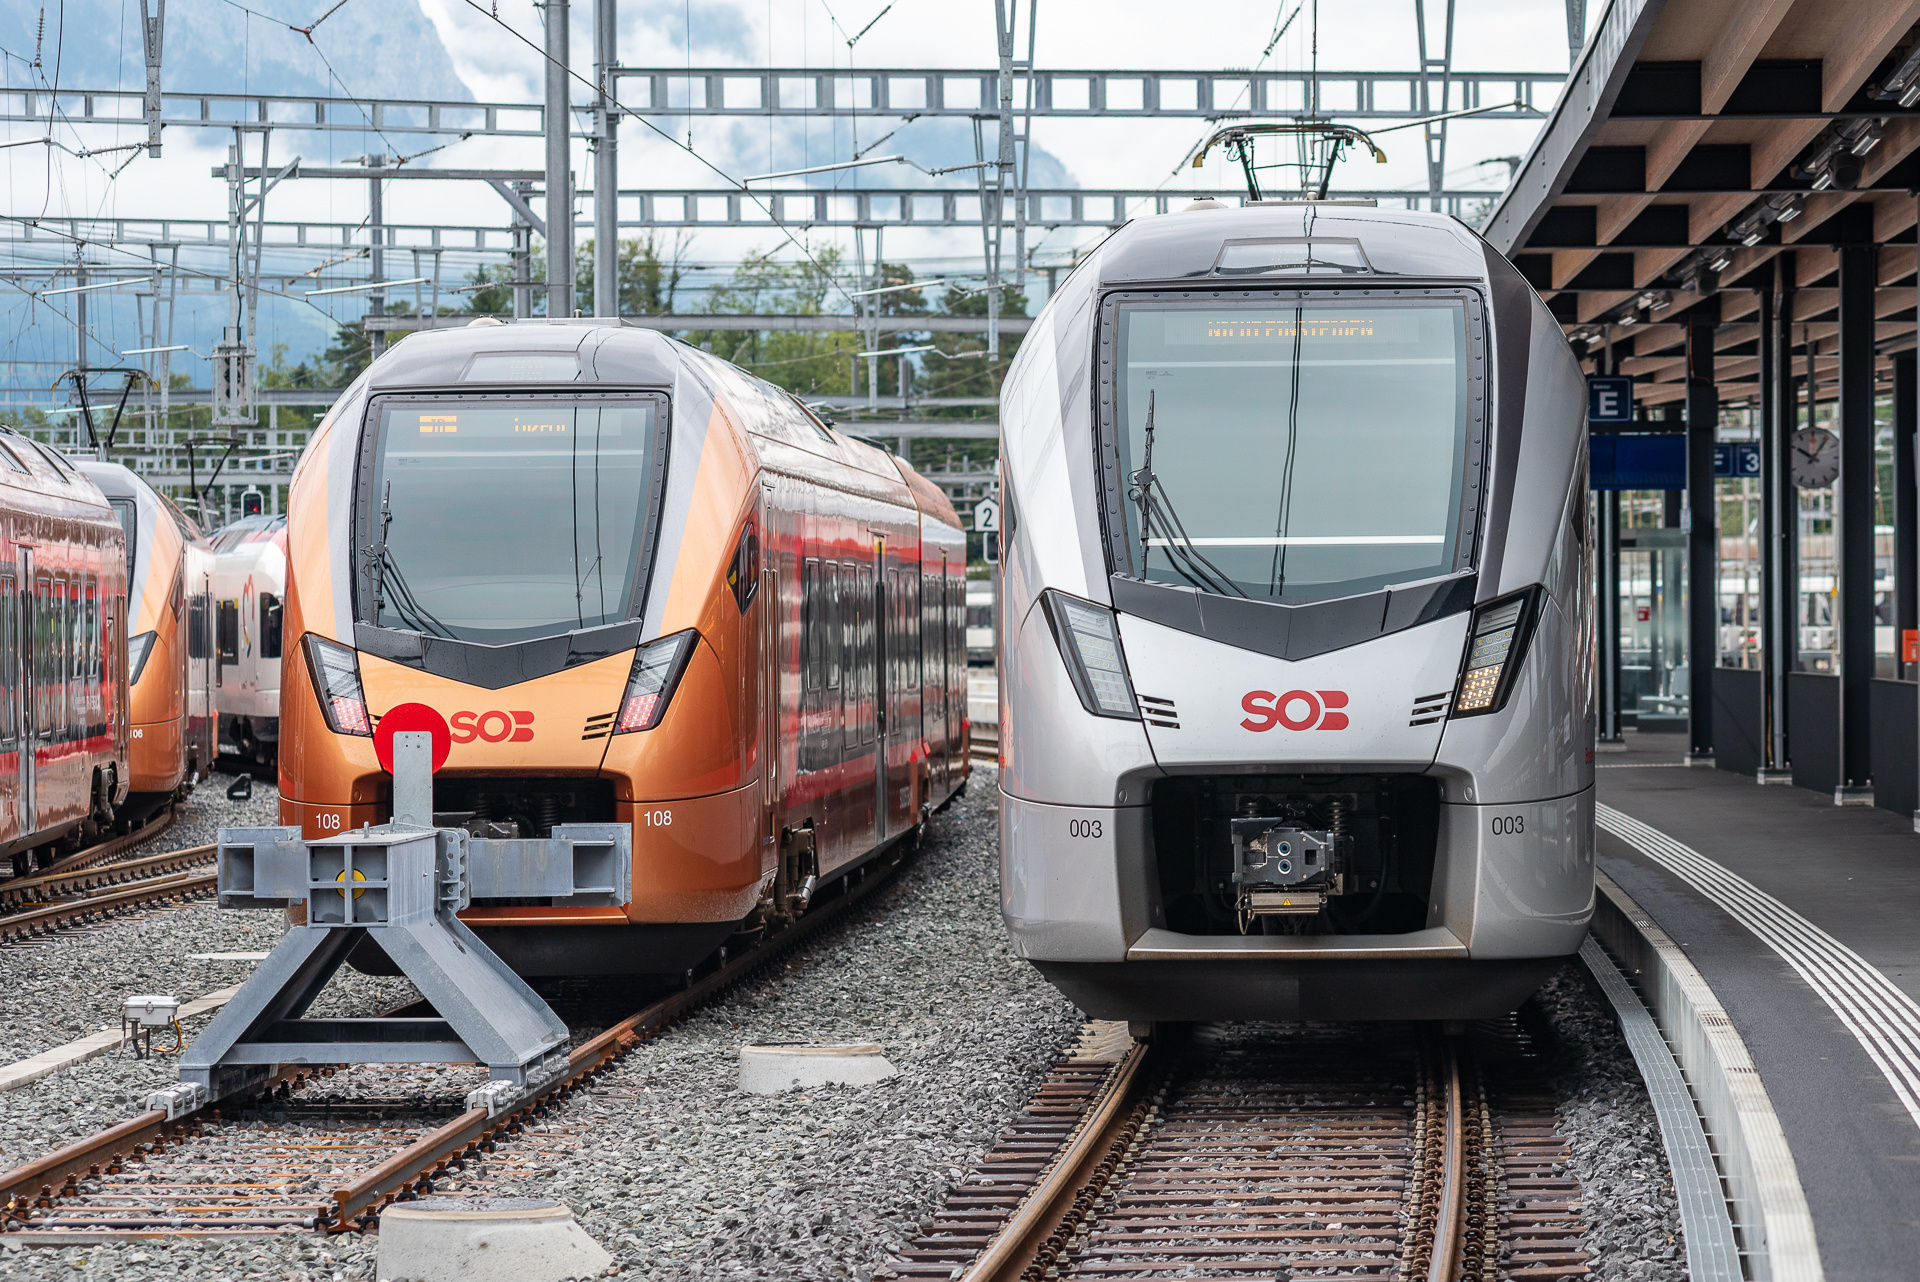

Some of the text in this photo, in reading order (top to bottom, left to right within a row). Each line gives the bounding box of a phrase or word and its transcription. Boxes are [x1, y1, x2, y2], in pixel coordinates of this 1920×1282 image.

[1599, 391, 1618, 416] E
[1745, 452, 1760, 472] 3
[983, 507, 993, 528] 2
[1239, 689, 1350, 733] SOB
[450, 710, 535, 744] SOB
[315, 812, 341, 830] 108
[643, 809, 673, 827] 108
[1069, 818, 1103, 839] 003
[1491, 815, 1525, 836] 003
